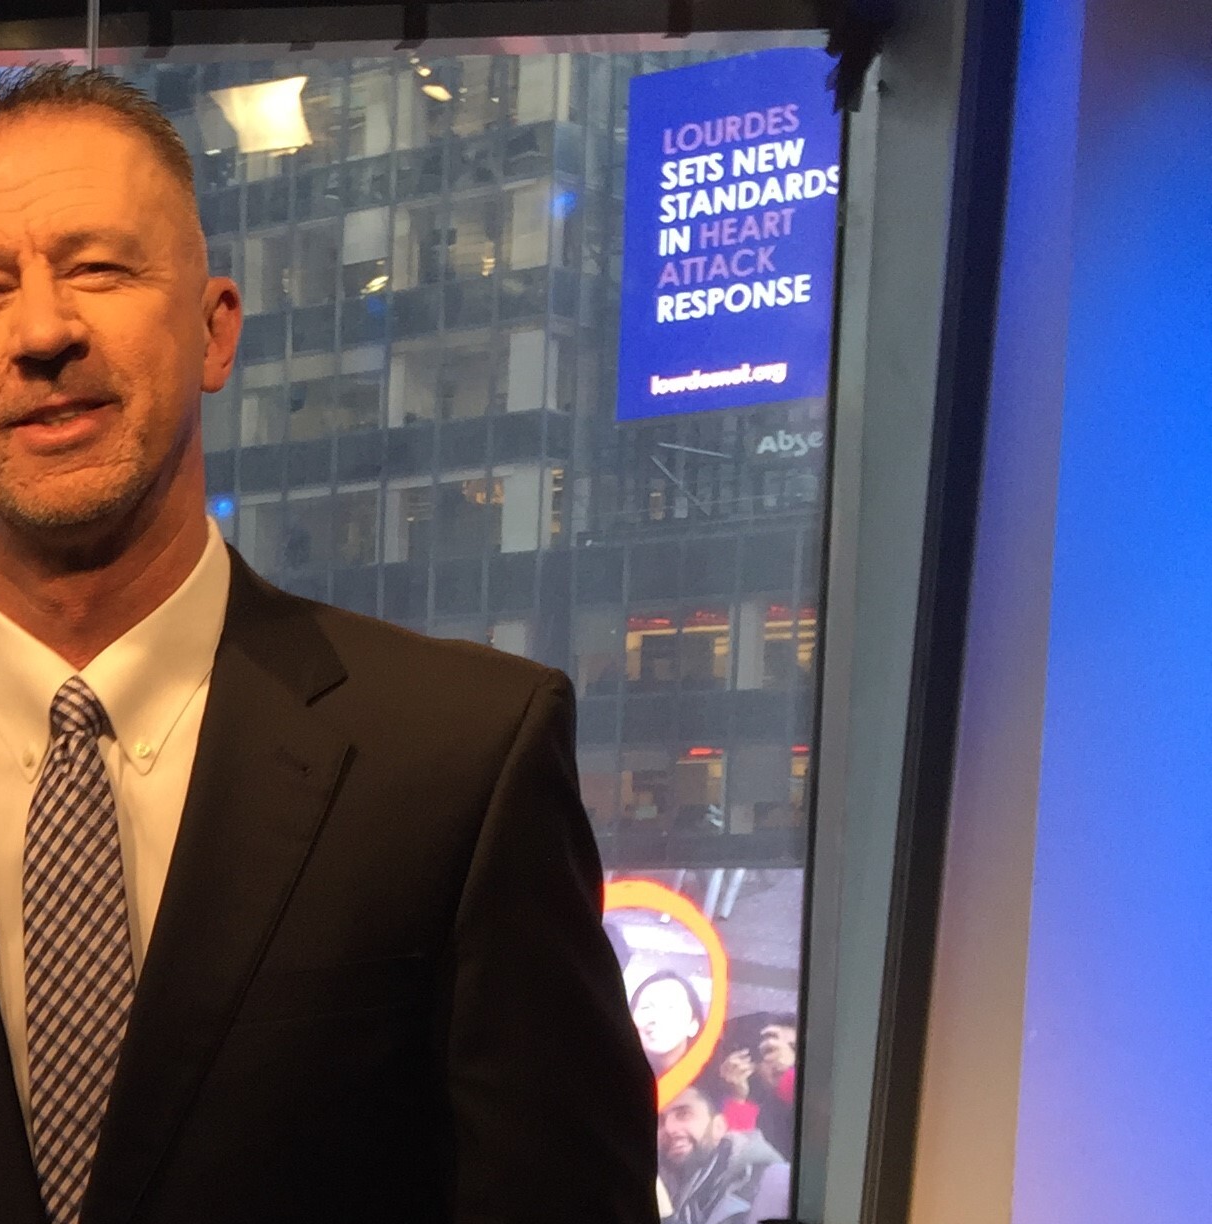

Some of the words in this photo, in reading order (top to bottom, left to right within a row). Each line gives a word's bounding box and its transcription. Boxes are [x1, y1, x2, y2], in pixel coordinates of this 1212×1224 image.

[662, 104, 800, 155] LOURDES
[660, 153, 724, 191] SETS
[731, 138, 805, 177] NEW
[658, 165, 840, 224] STANDARDS
[658, 228, 691, 256] IN
[699, 208, 797, 249] HEART
[656, 246, 777, 288] ATTACK
[656, 274, 812, 324] RESPONSE
